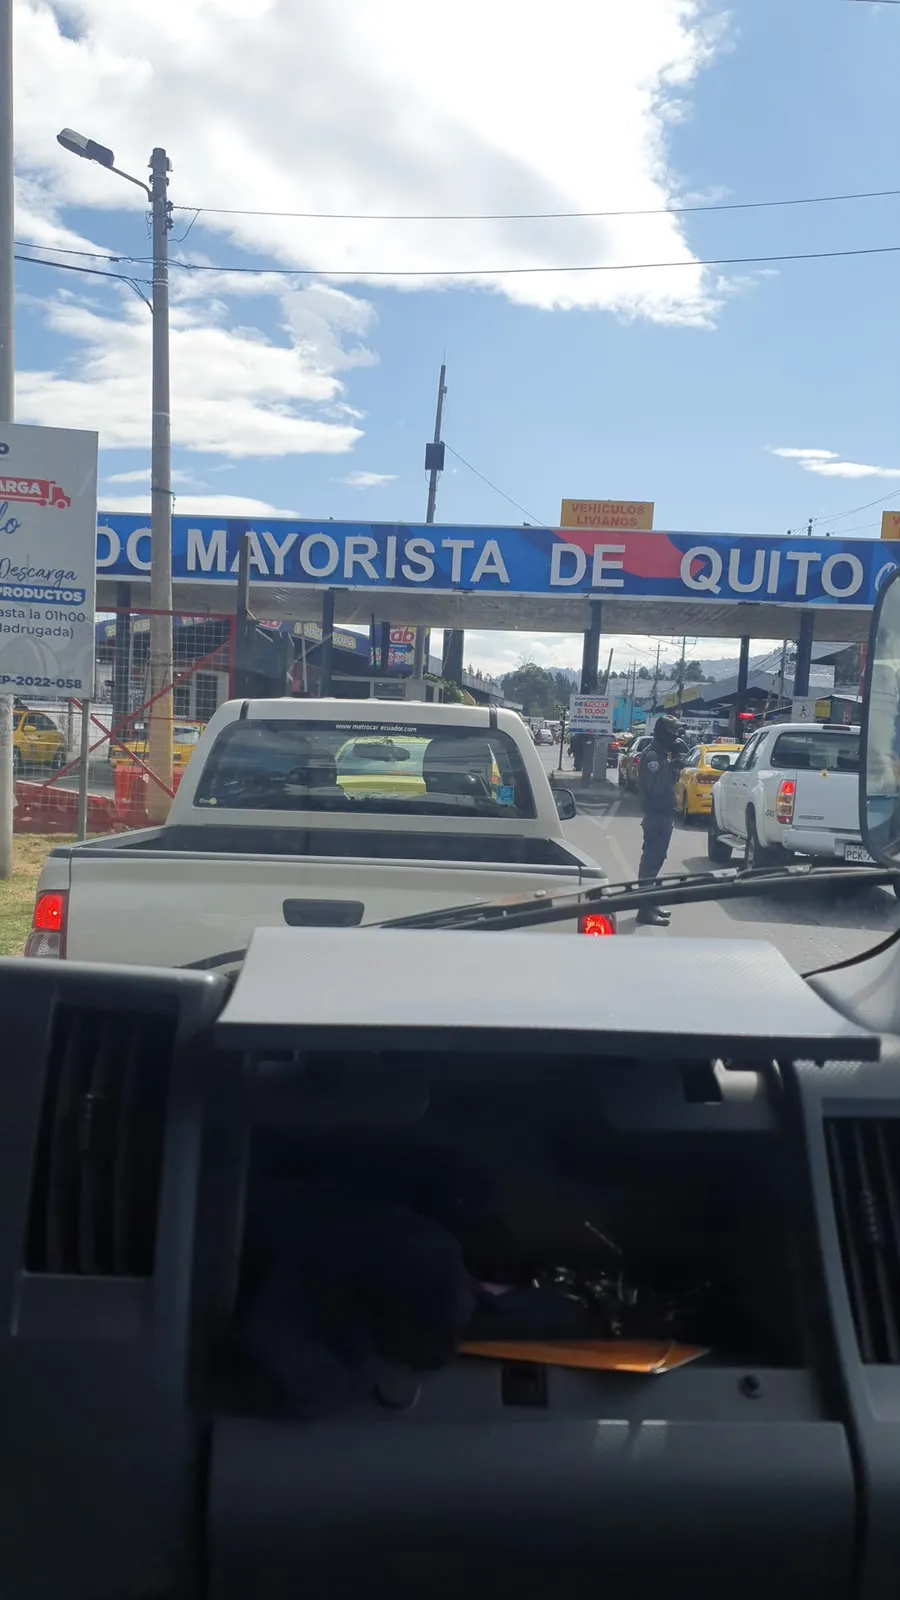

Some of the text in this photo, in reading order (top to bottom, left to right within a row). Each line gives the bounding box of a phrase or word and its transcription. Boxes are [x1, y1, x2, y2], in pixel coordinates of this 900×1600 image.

[571, 503, 645, 515] VEHICULOS
[576, 515, 638, 527] LIVIANOS
[186, 528, 511, 584] MAYORISTA
[550, 542, 627, 588] DE
[680, 546, 864, 598] QUITO
[0, 557, 78, 588] Descarga
[30, 608, 41, 620] la
[45, 610, 86, 622] 01h00
